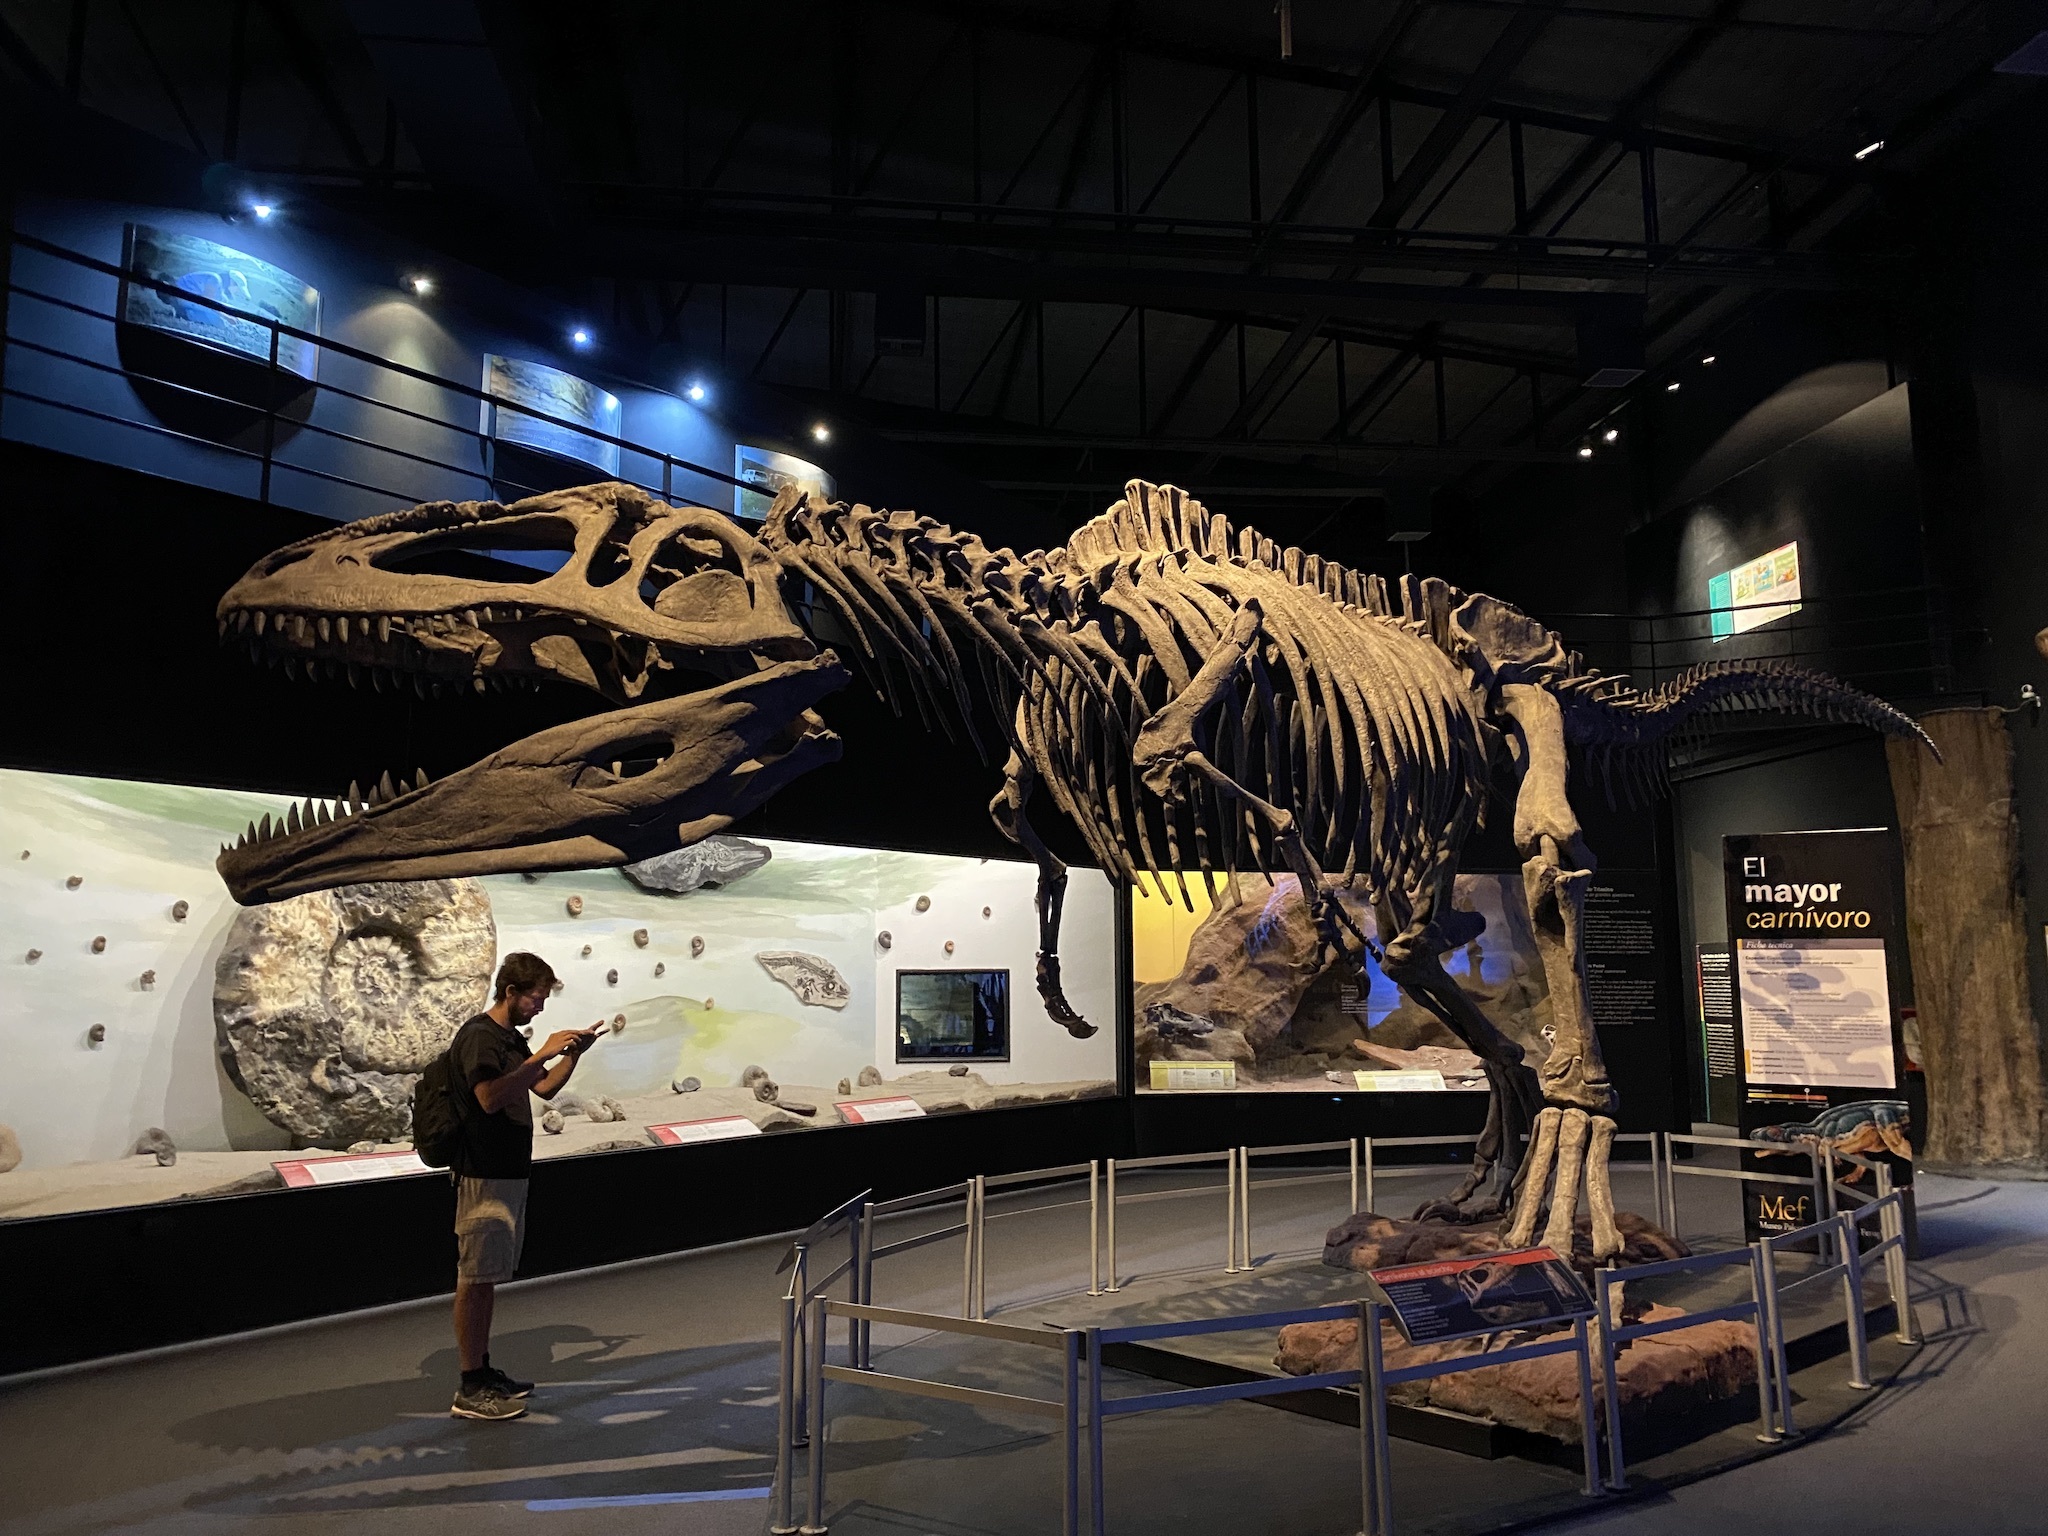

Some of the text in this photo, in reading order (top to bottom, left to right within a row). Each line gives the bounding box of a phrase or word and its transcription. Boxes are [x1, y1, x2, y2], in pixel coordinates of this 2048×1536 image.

[1743, 856, 1766, 878] El
[1745, 882, 1842, 908] mayor
[1746, 906, 1871, 929] carnívoro
[1758, 1194, 1810, 1221] Mef
